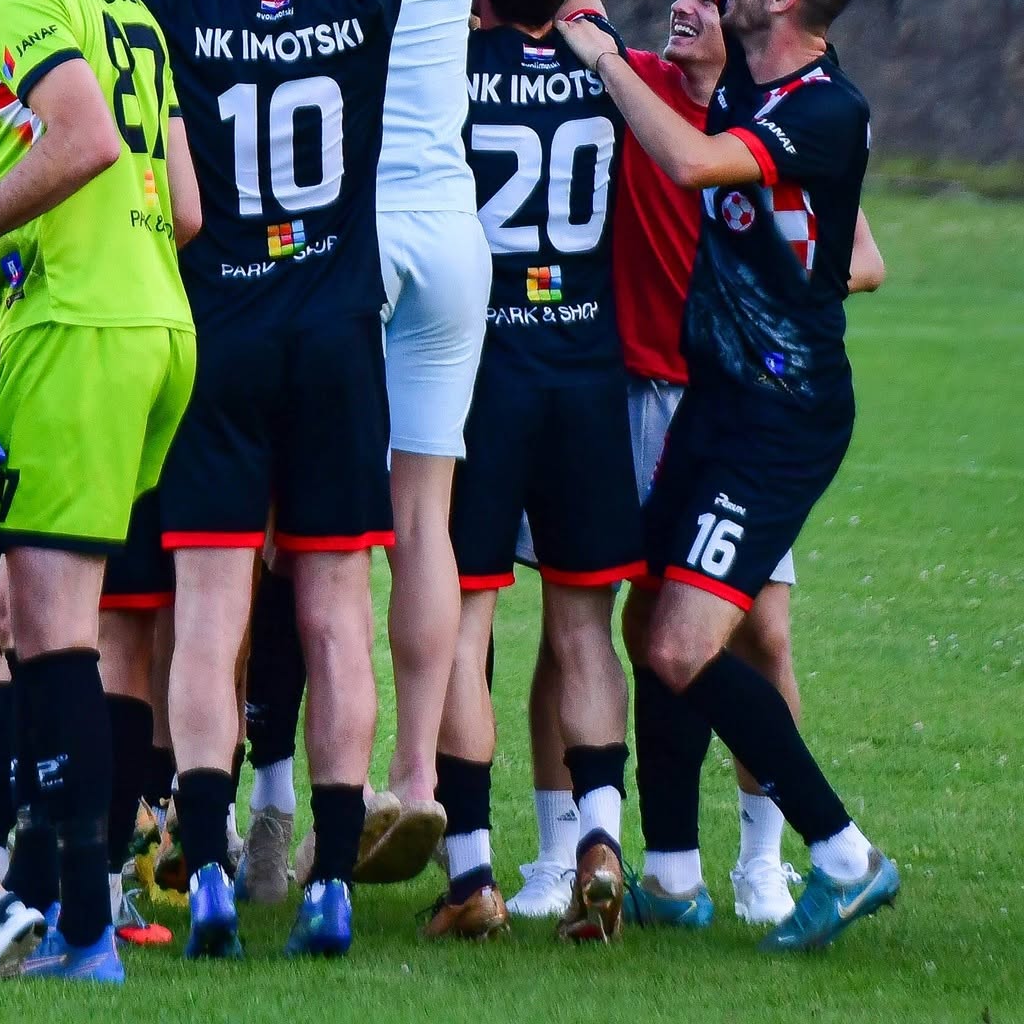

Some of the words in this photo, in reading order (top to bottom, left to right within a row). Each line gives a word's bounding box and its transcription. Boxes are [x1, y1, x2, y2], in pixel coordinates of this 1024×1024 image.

[15, 24, 59, 58] JANAF
[195, 26, 234, 59] NK
[242, 17, 365, 61] IMOTSKI
[102, 9, 166, 161] 87
[510, 69, 609, 104] IMOTS
[216, 75, 345, 216] 10
[755, 117, 799, 156] JANAF
[470, 115, 616, 255] 20
[486, 306, 539, 325] PARK
[542, 305, 557, 323] &
[686, 512, 745, 577] 16
